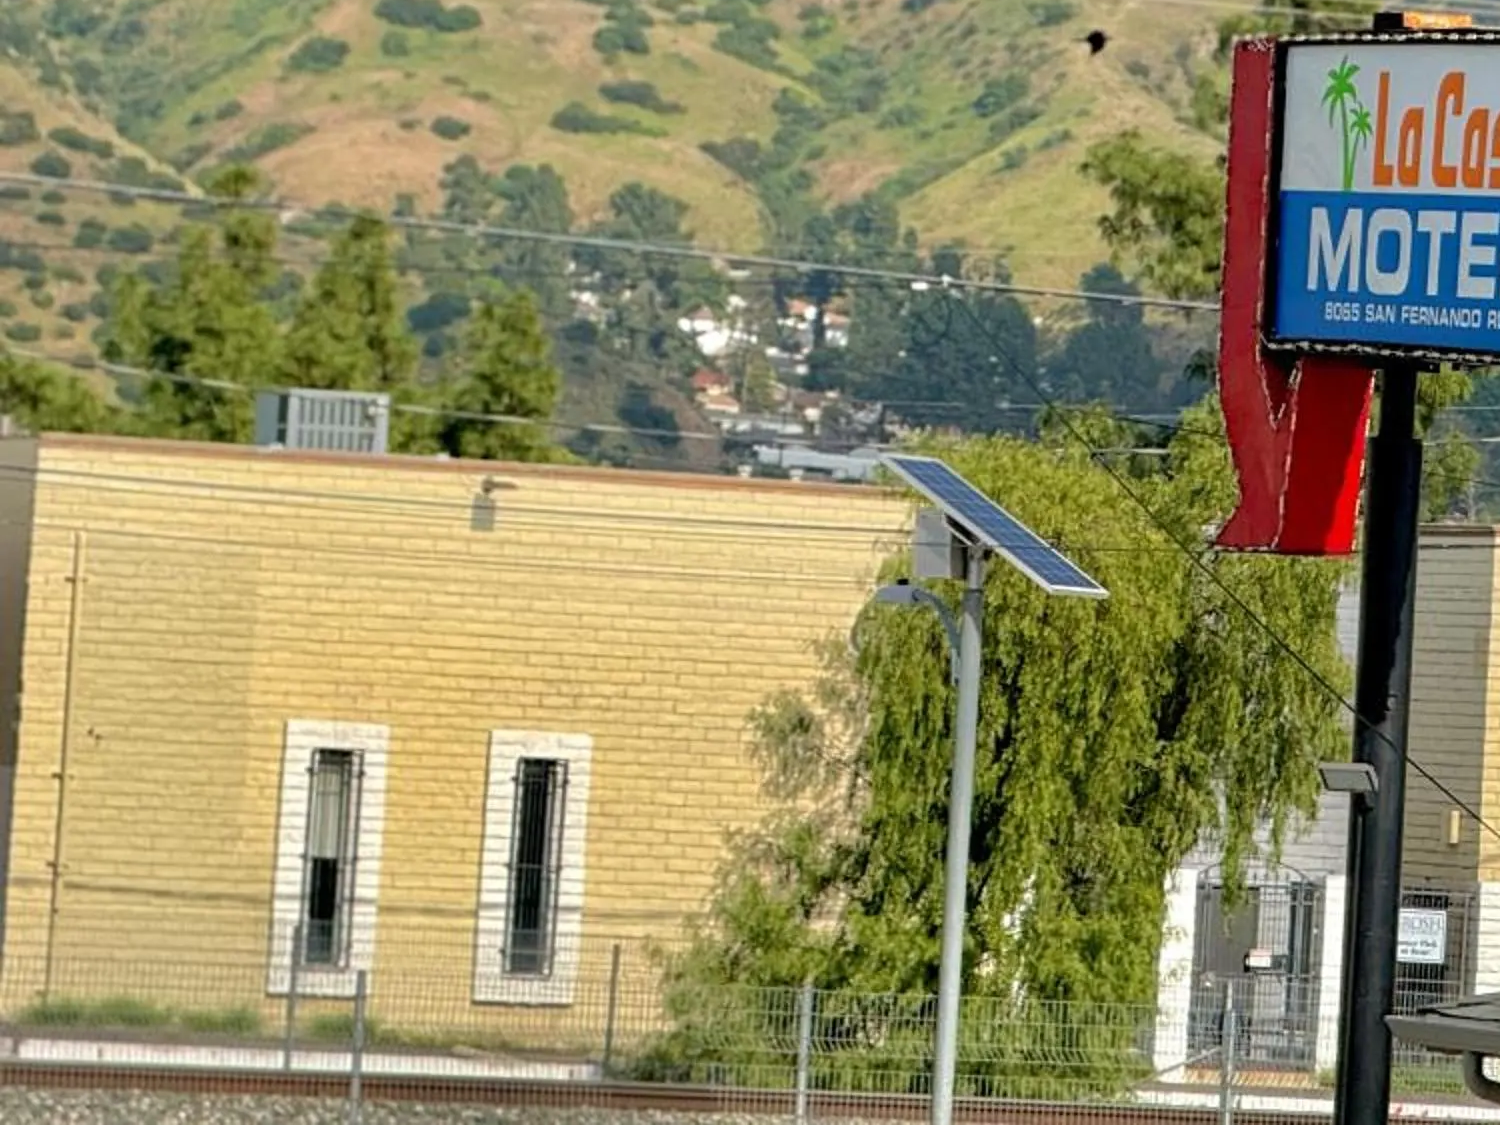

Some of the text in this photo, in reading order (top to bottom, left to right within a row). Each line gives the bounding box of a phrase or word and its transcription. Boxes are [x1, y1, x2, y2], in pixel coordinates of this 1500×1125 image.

[1372, 71, 1425, 188] La
[1365, 303, 1396, 324] SAN
[1401, 305, 1482, 329] FERNANDO
